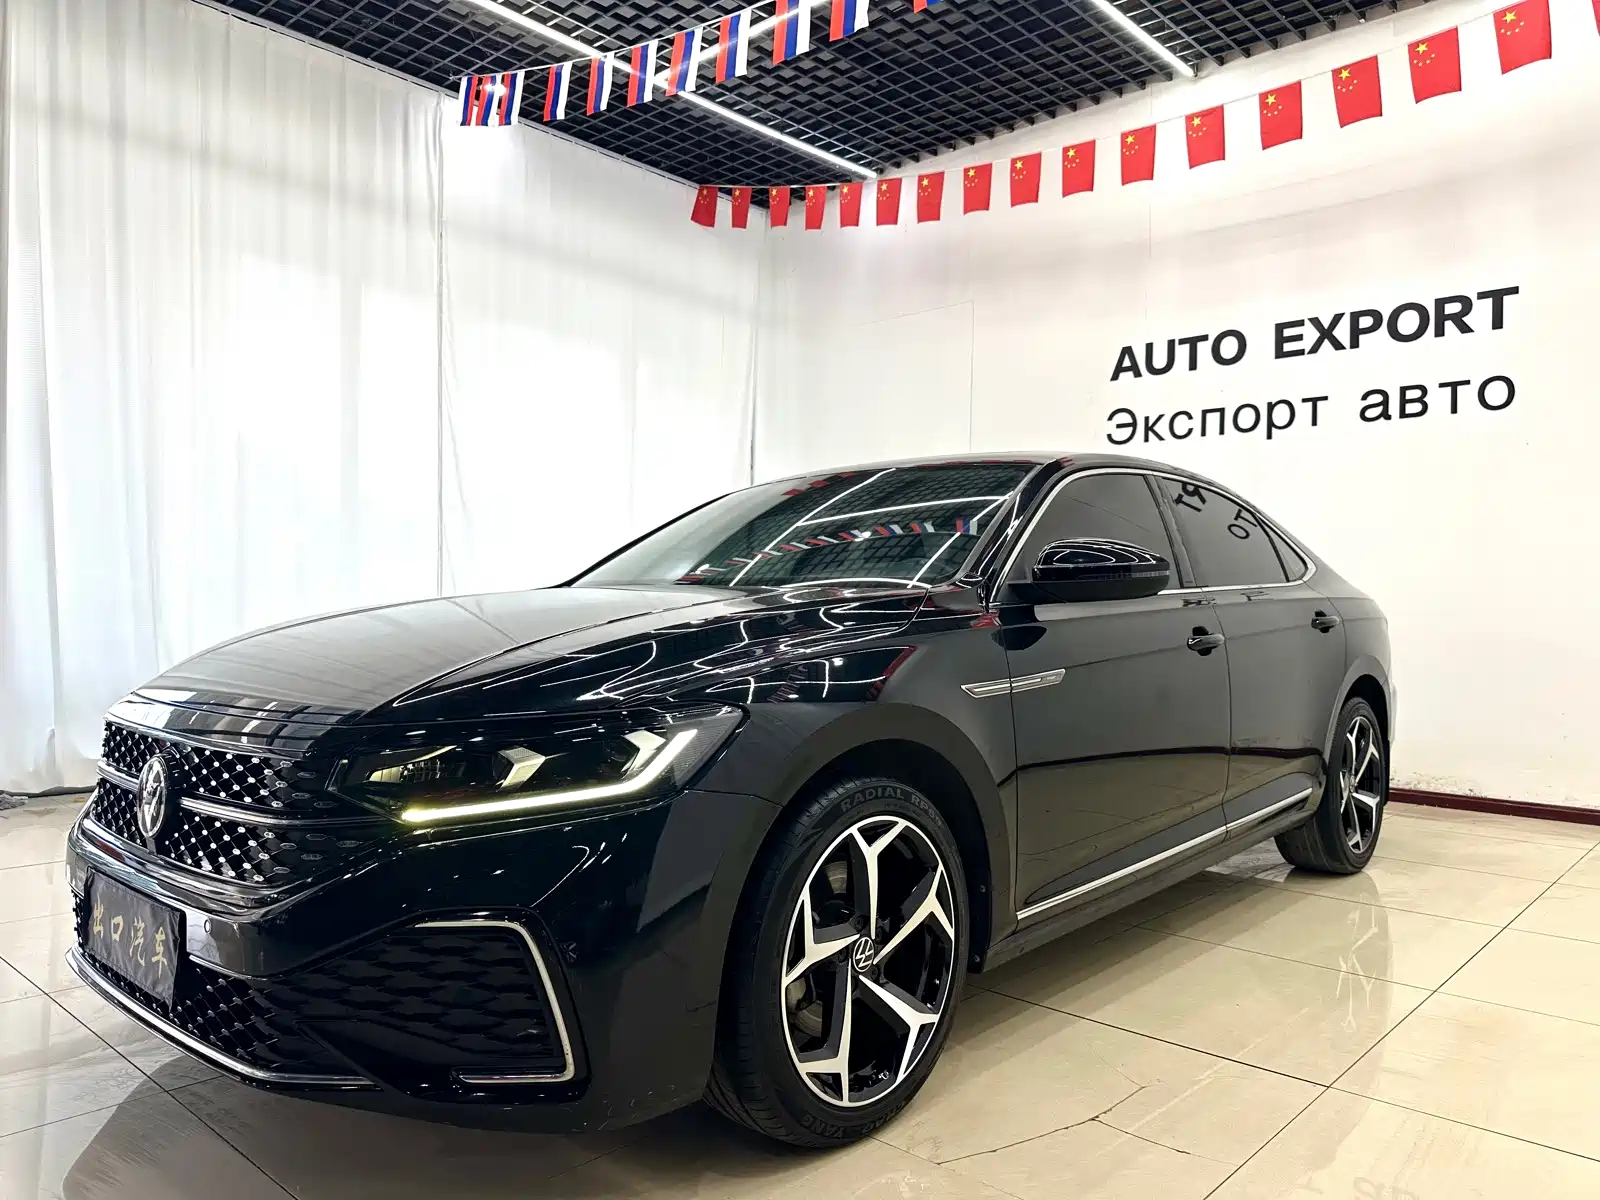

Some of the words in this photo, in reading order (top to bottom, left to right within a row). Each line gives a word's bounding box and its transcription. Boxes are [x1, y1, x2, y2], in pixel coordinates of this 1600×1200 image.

[1110, 329, 1247, 382] AUTO
[1274, 285, 1520, 360] EXPORT
[1106, 395, 1329, 446] Экспорт
[1359, 375, 1516, 423] авто
[840, 786, 904, 814] RADIAL
